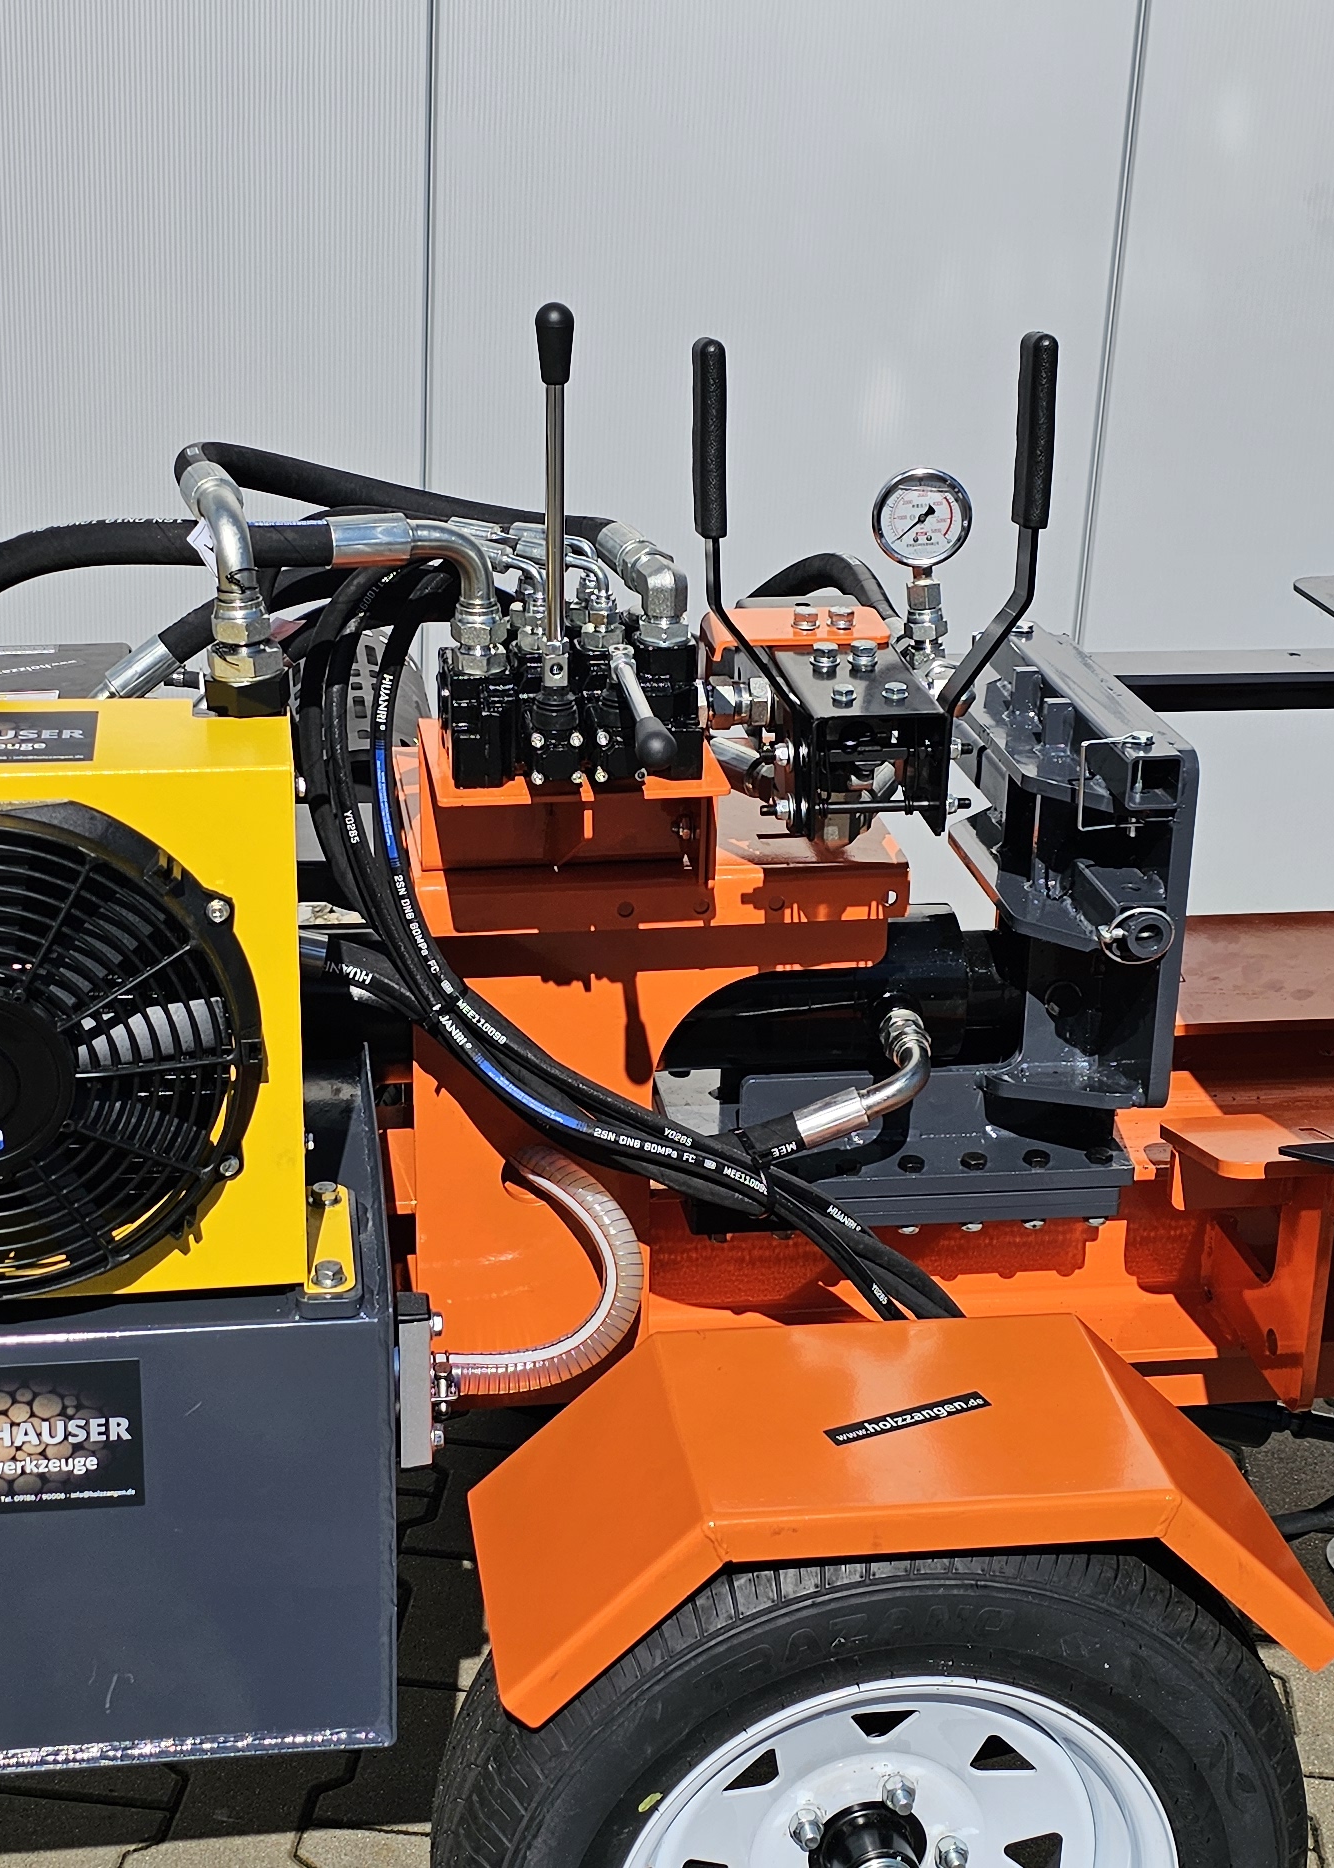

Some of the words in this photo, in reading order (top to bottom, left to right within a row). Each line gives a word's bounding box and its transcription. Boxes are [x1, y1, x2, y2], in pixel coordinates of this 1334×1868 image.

[394, 875, 407, 896] 2SN
[427, 959, 439, 974] FC
[593, 1127, 616, 1142] 2SN
[682, 1152, 697, 1164] FC
[835, 1397, 985, 1442] www.holzzangen.de
